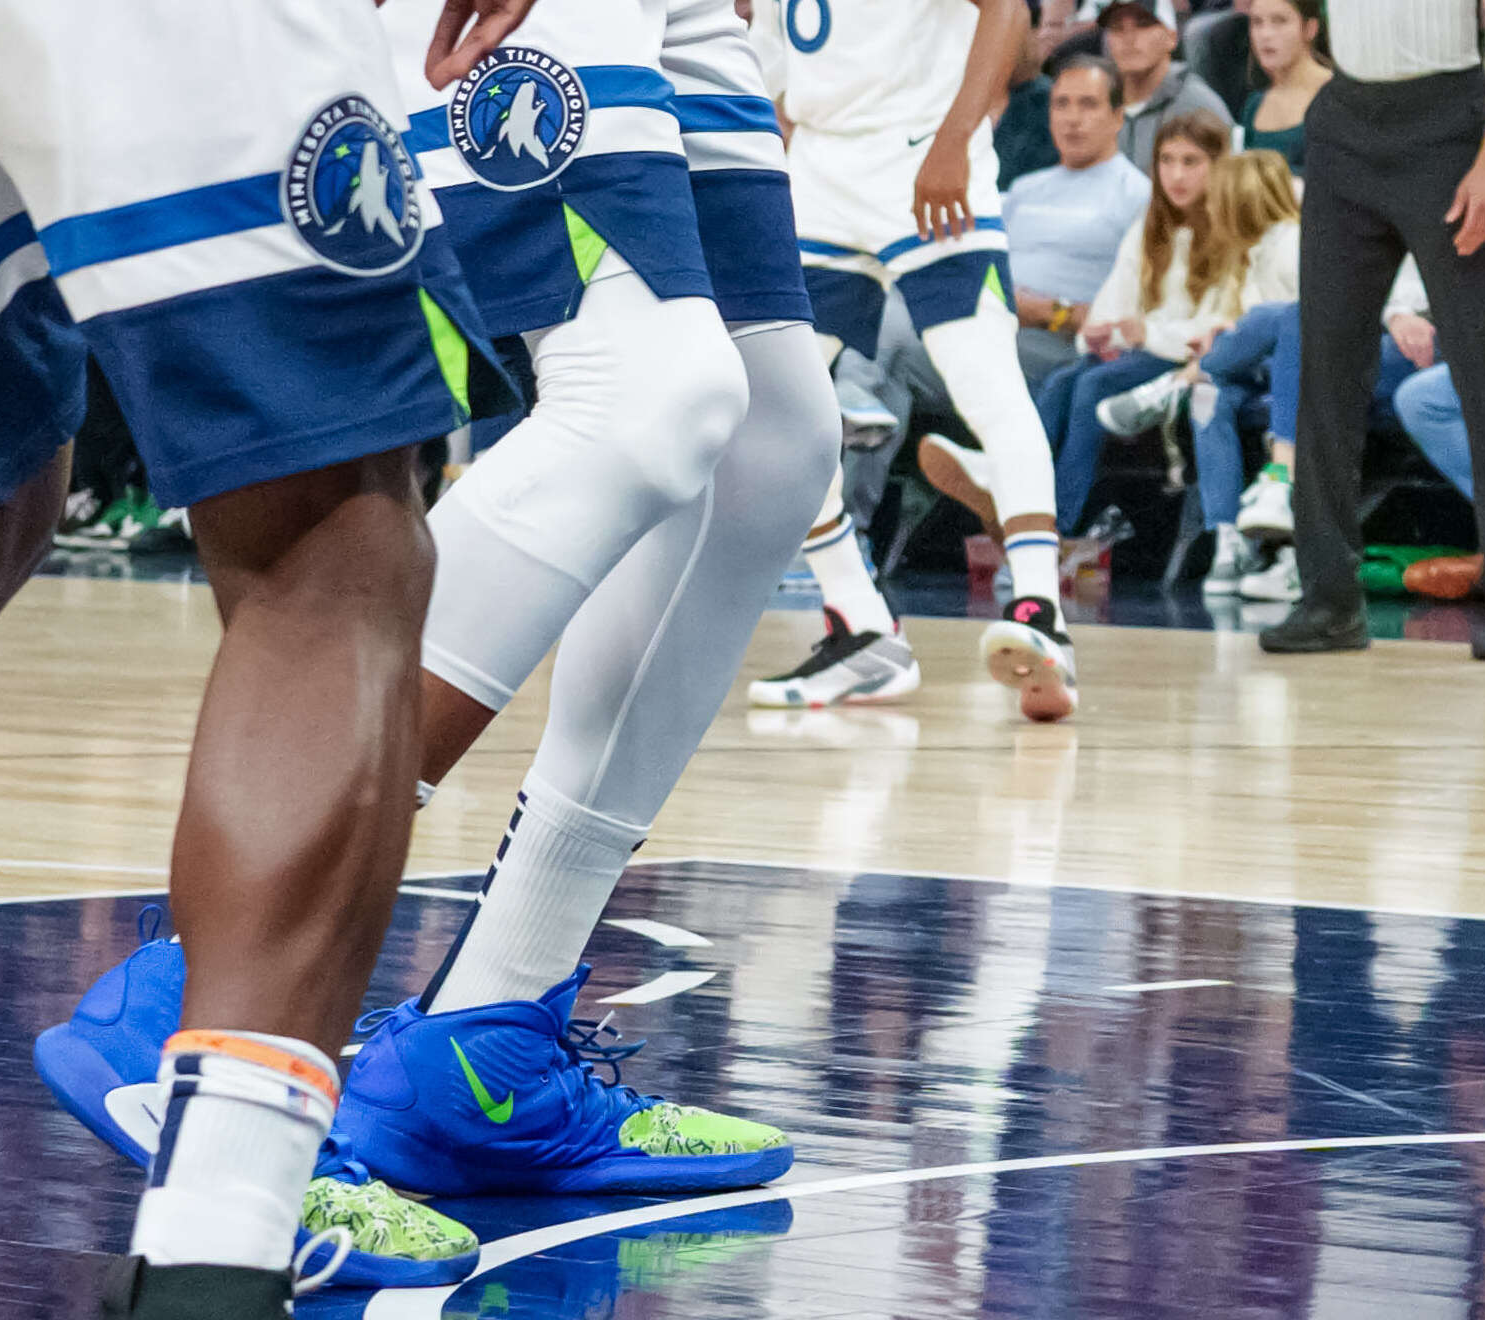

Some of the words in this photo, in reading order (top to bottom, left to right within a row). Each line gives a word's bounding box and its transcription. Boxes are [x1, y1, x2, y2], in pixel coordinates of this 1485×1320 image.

[453, 56, 499, 153] MINNESOTA
[506, 48, 588, 154] TIMBERWOLVES
[288, 108, 345, 227] MINNESOTA
